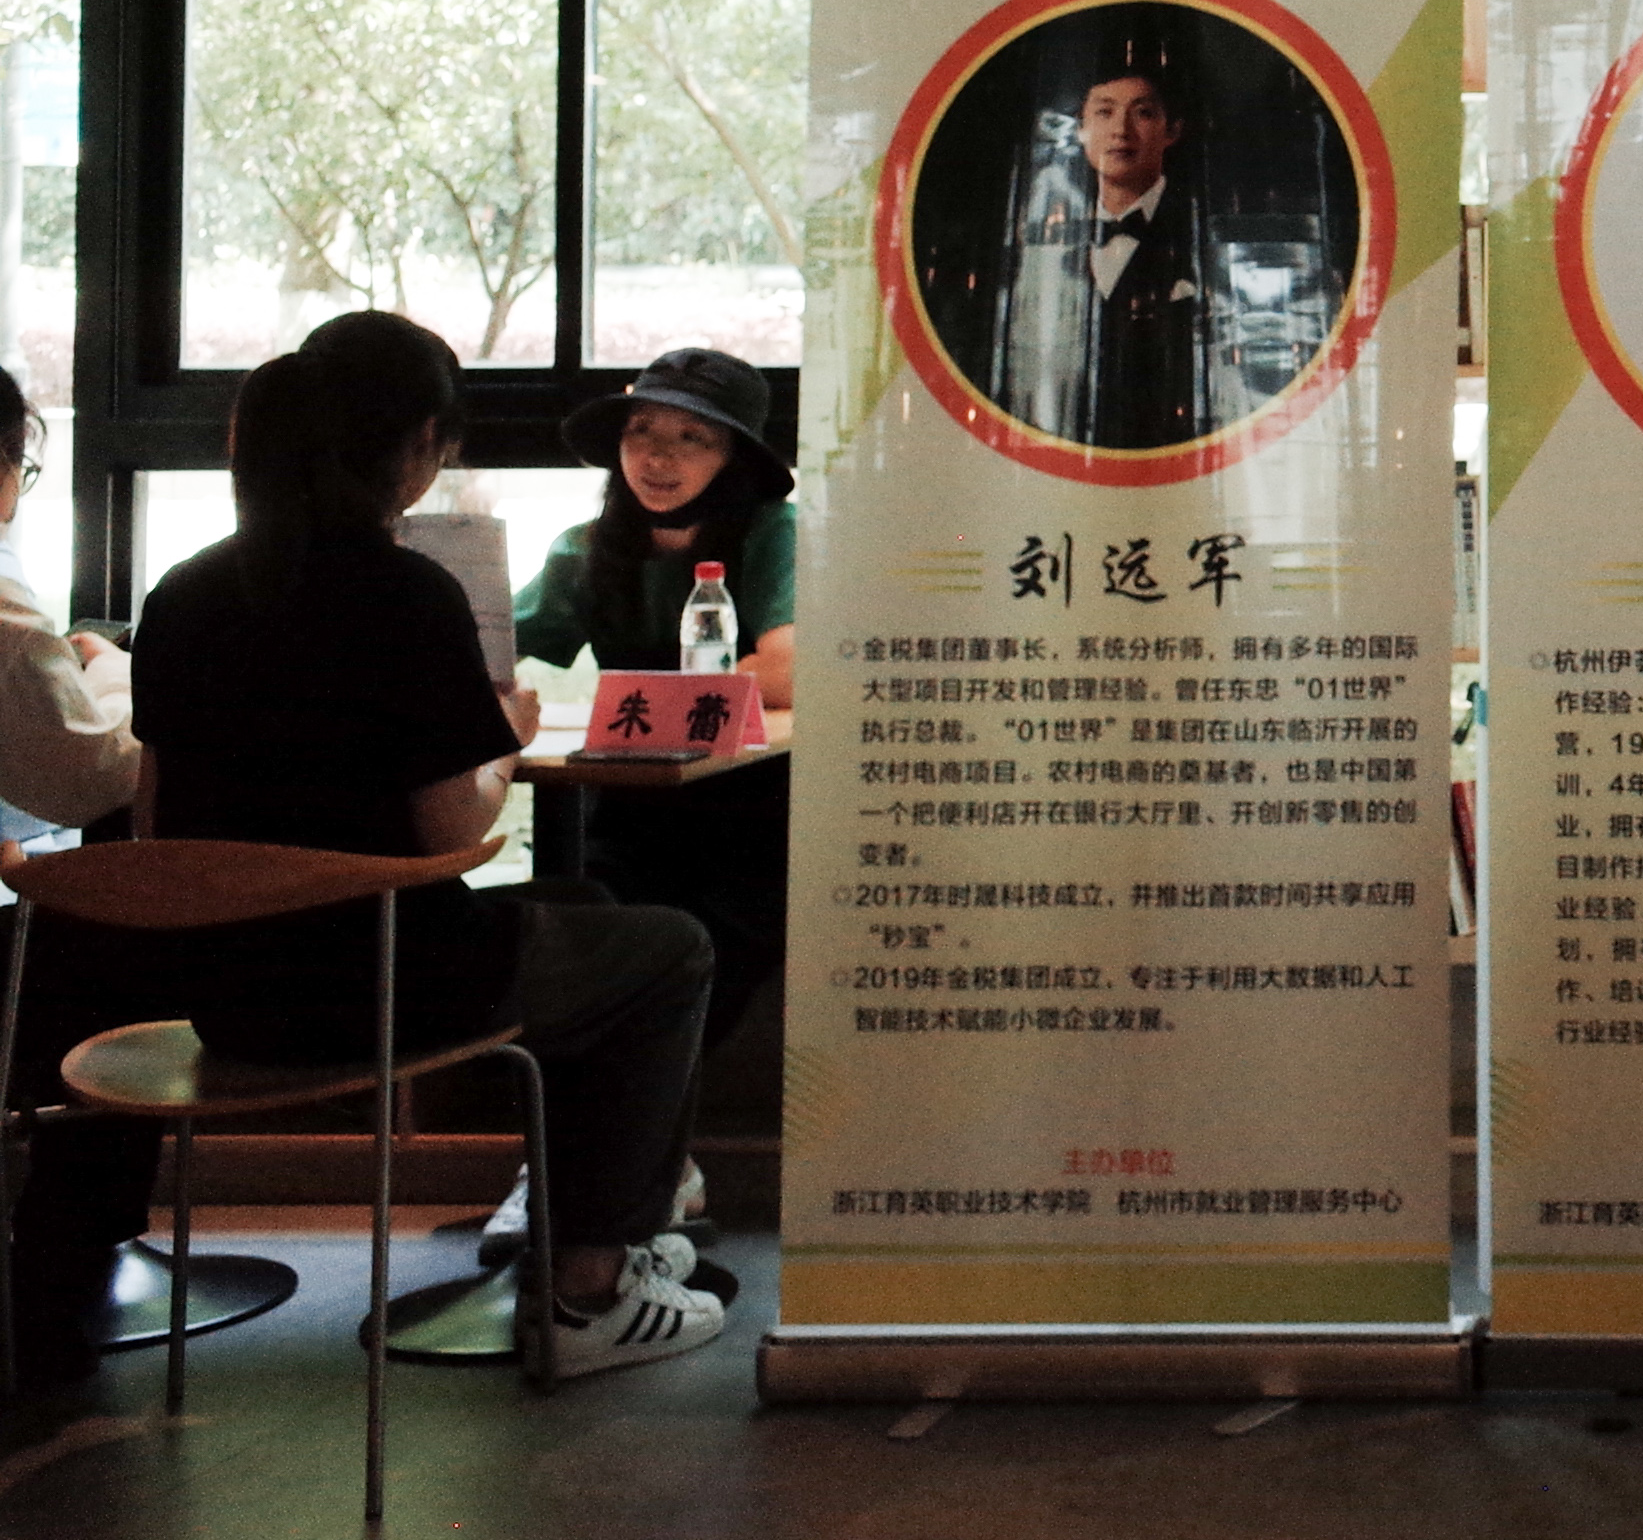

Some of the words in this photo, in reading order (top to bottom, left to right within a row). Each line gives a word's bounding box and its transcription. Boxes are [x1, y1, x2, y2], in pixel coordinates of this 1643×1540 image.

[1008, 530, 1248, 609] 刘远军
[1060, 1149, 1176, 1178] 主办单位
[832, 1189, 1092, 1217] 浙江育英职业技术学院
[1116, 1189, 1404, 1217] 杭州市就业管理服务中心
